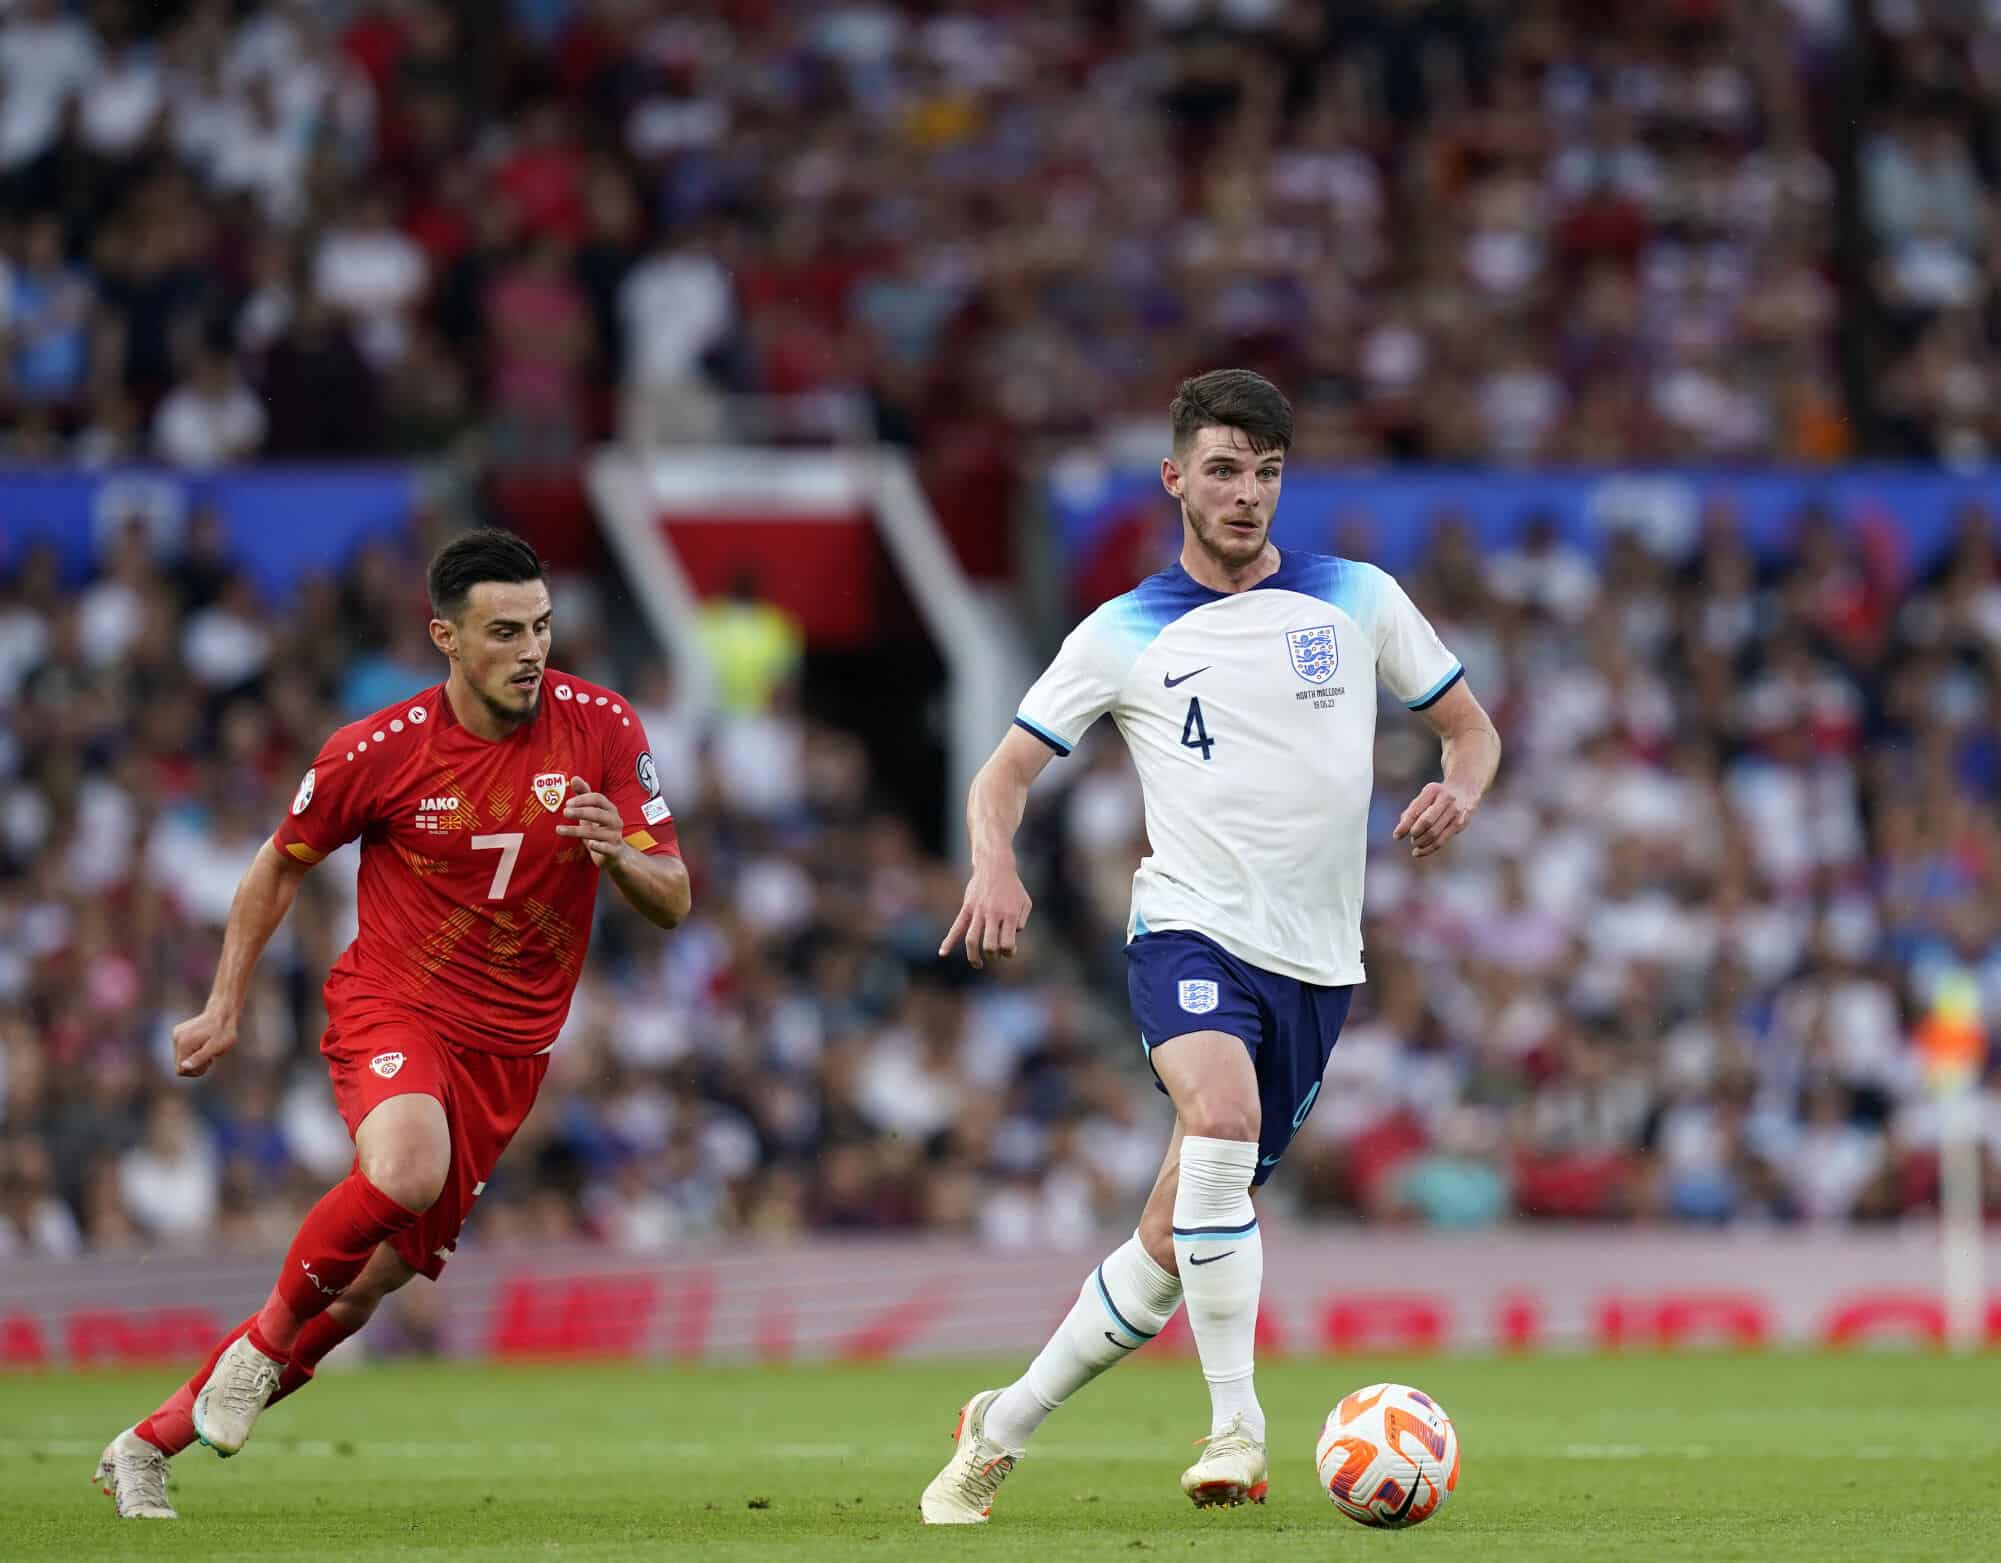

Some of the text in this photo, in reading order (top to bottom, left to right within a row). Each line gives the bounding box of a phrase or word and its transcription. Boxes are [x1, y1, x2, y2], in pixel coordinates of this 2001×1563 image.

[1181, 696, 1215, 760] 4
[537, 776, 563, 788] ФФМ
[418, 797, 459, 811] JAKO
[471, 832, 525, 900] 7
